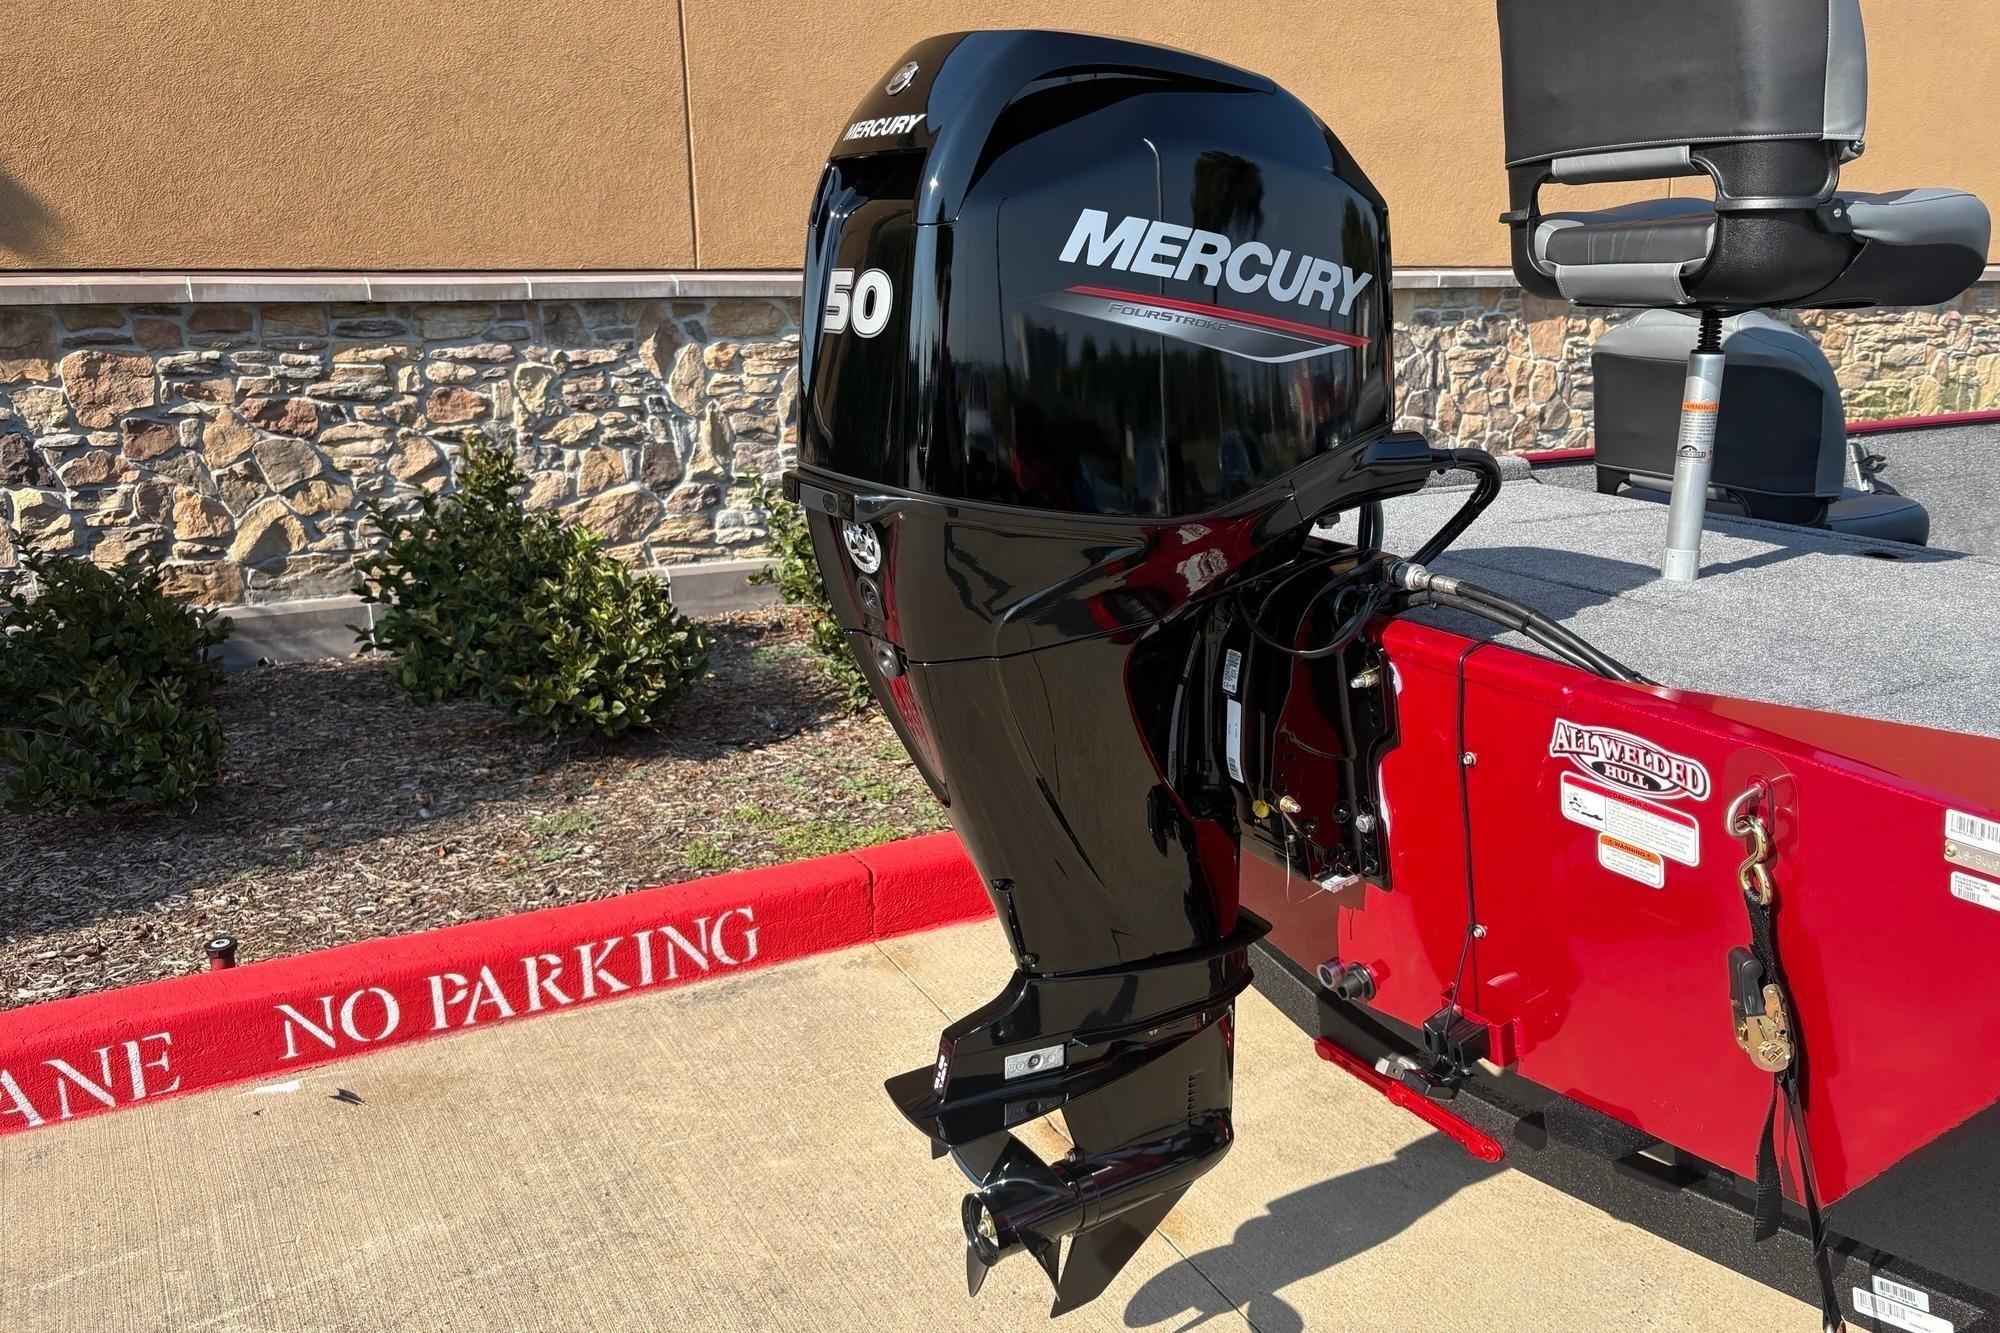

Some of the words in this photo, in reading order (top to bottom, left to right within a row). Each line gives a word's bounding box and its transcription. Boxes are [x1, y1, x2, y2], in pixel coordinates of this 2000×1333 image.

[843, 114, 927, 141] MERCURY
[1058, 208, 1373, 316] MERCURY
[823, 268, 893, 338] 50
[1107, 302, 1229, 331] FOURSTROKE
[1553, 722, 1599, 756] ALL
[1600, 734, 1708, 797] WELDED
[1604, 763, 1649, 790] HULL
[1615, 842, 1646, 857] WARNING
[275, 987, 400, 1059] NO
[427, 905, 760, 1031] PARKING
